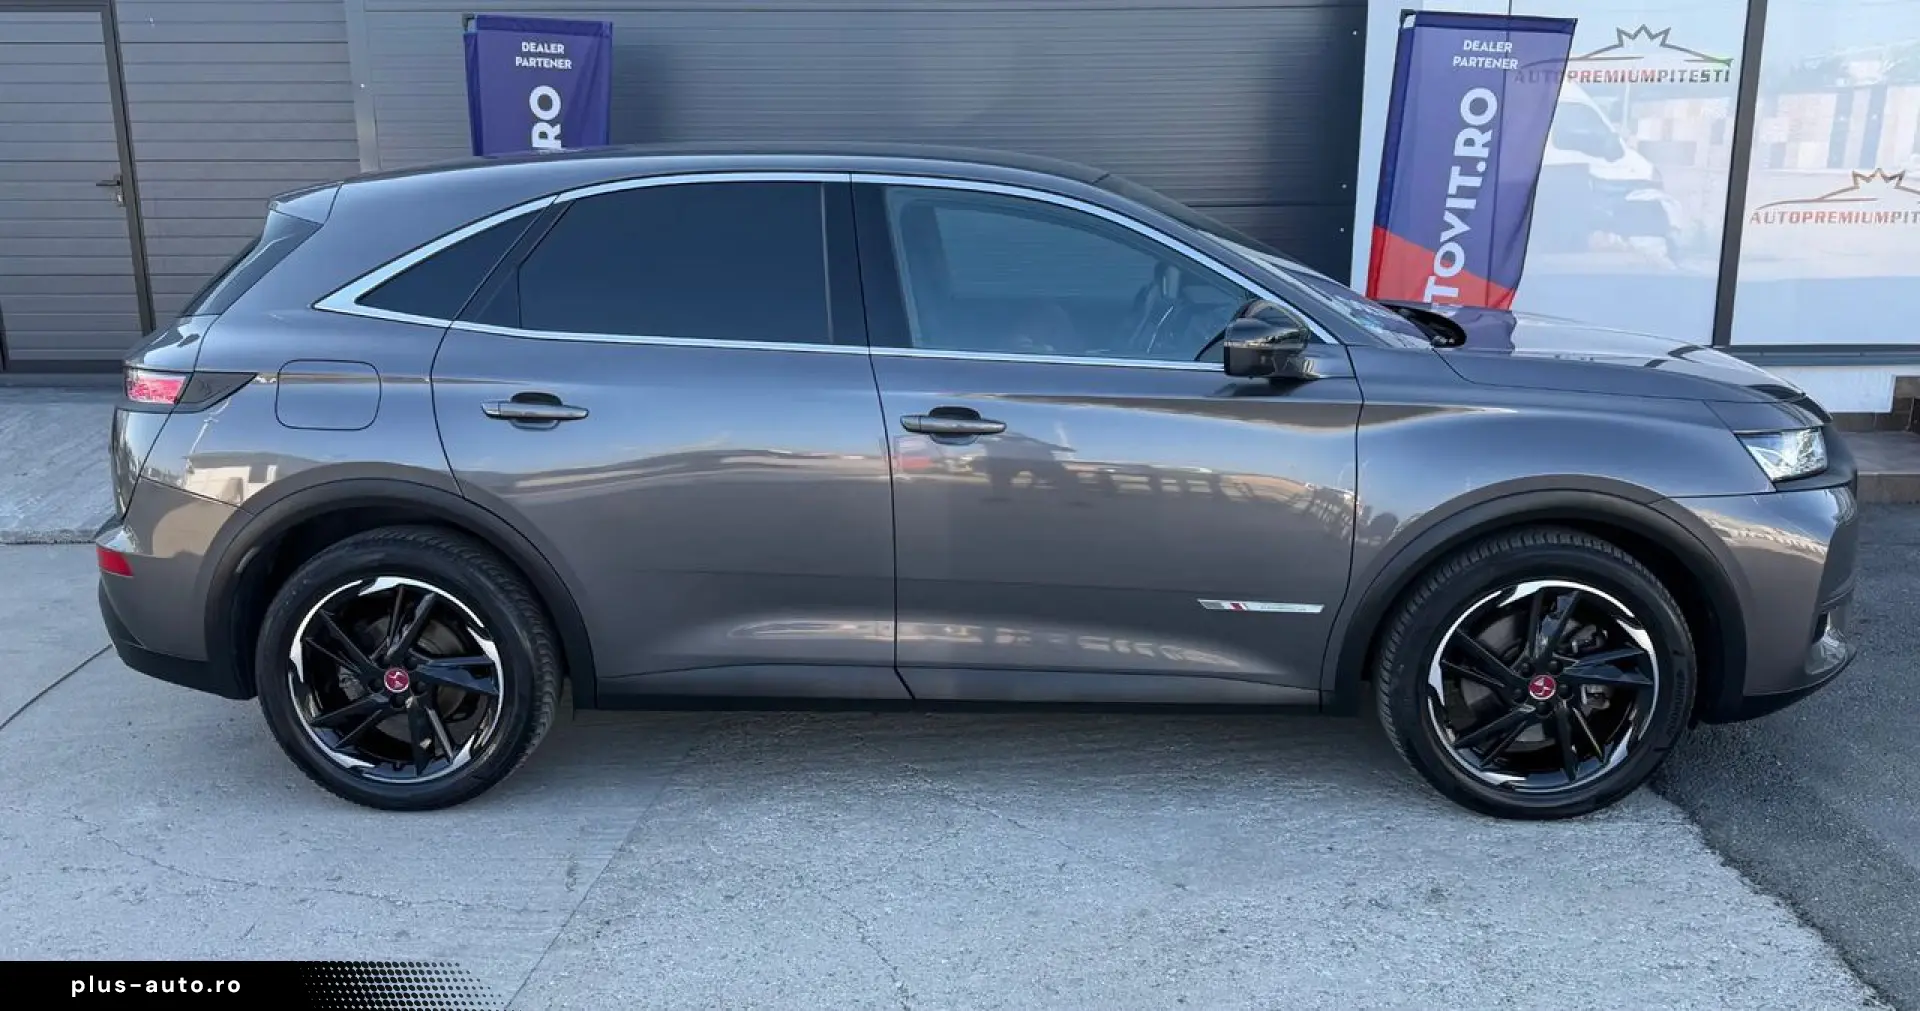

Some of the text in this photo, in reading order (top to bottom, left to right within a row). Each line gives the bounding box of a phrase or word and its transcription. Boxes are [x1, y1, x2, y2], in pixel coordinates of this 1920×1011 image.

[521, 41, 565, 54] DEALER
[1463, 40, 1513, 53] DEALER
[515, 56, 573, 69] PARTENER
[1453, 56, 1518, 70] PARTENER
